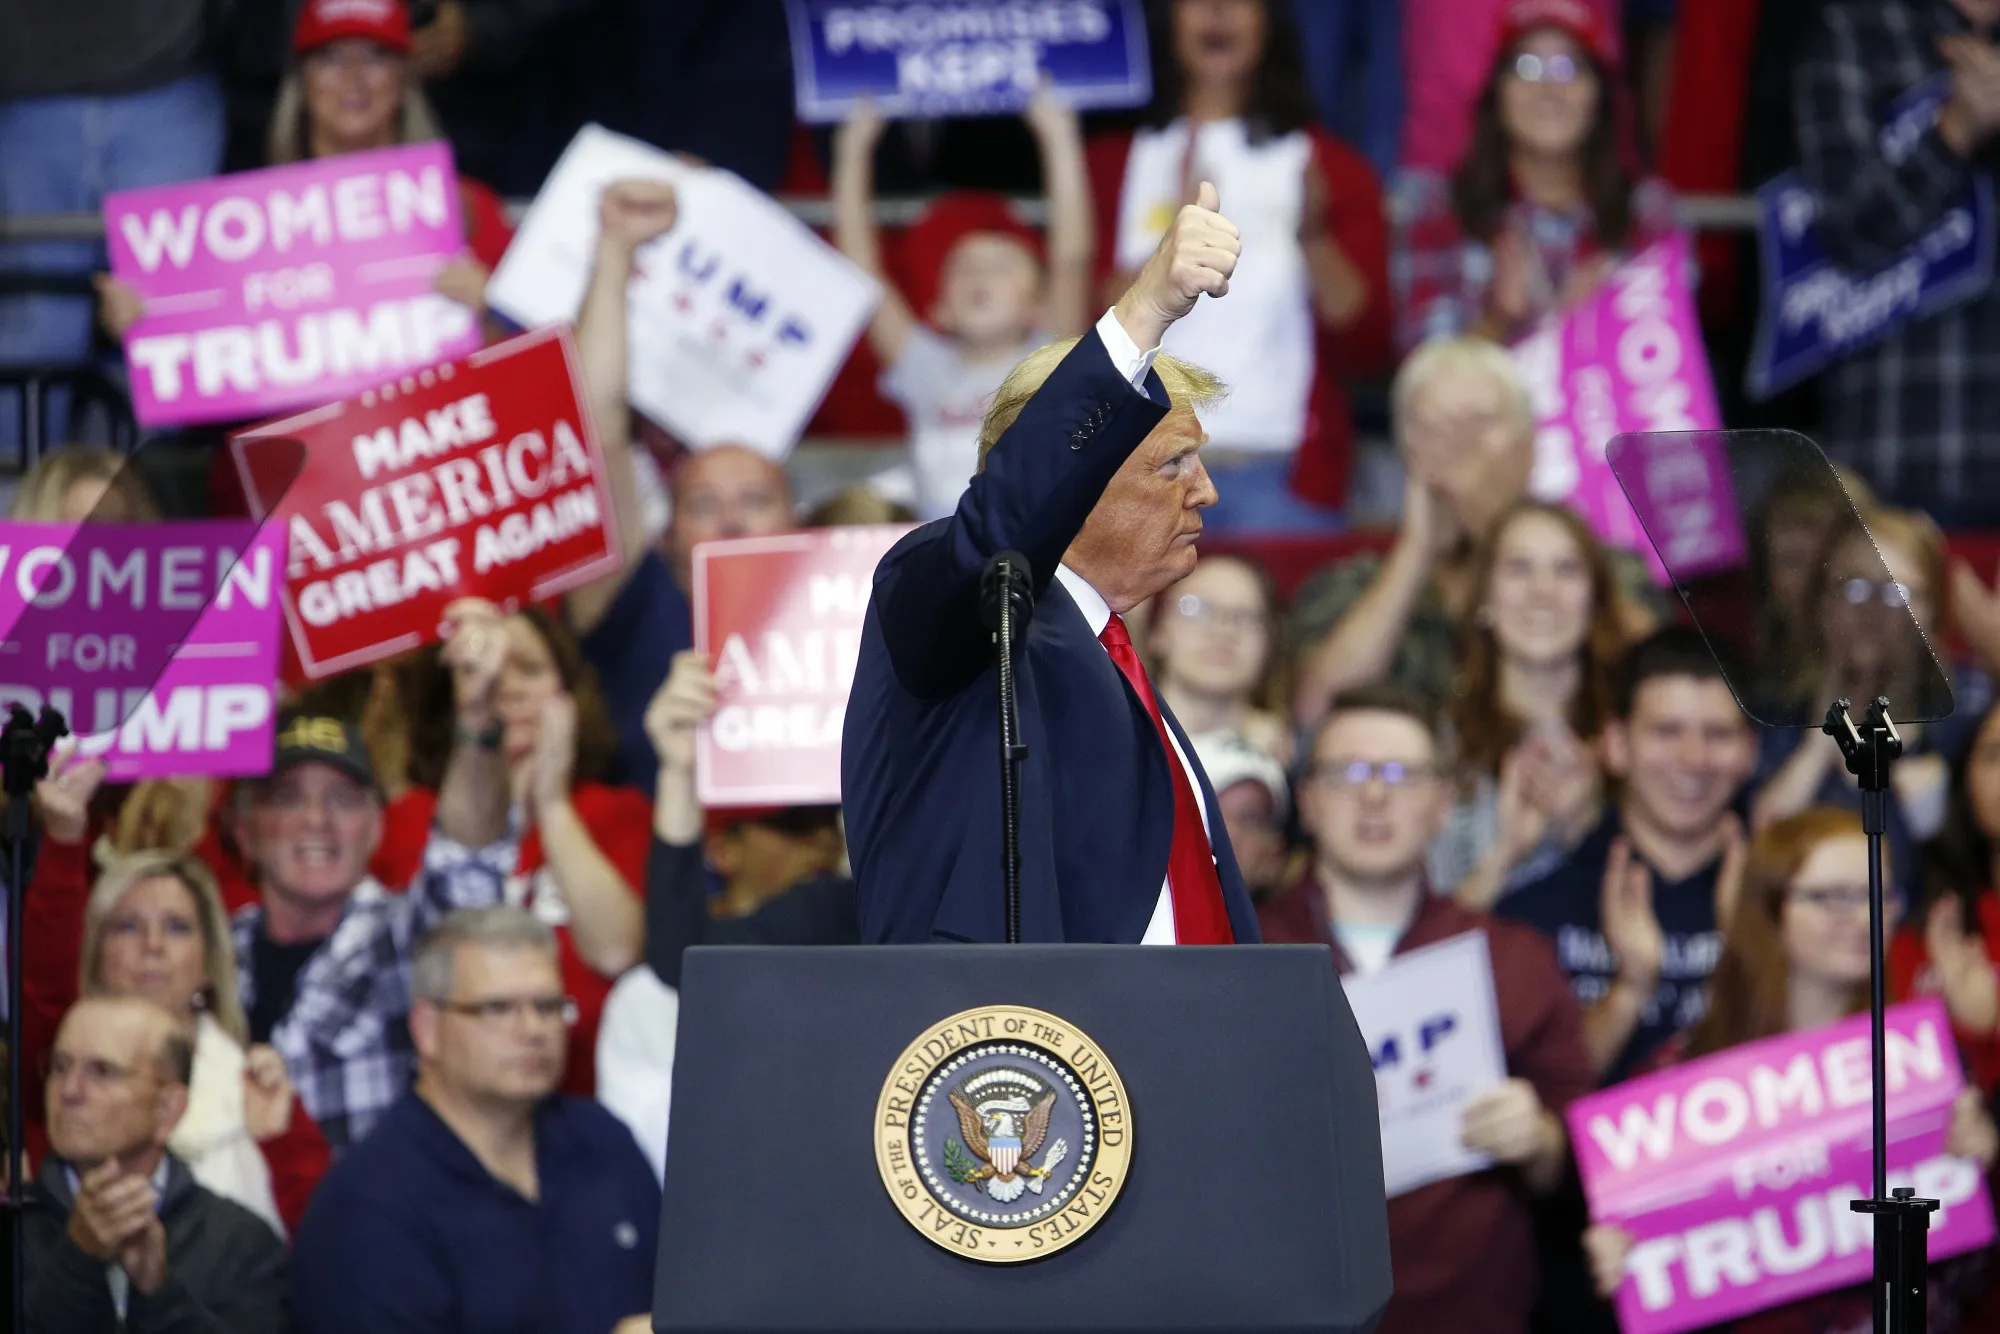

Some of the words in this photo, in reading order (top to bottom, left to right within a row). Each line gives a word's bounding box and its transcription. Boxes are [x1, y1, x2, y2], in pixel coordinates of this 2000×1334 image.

[119, 163, 449, 274] WOMEN
[242, 261, 335, 314] FOR
[655, 236, 814, 350] UMP
[130, 293, 474, 403] TRUMP
[351, 392, 498, 480] MAKE
[286, 417, 596, 579] AMERICA
[0, 544, 273, 611] OMEN
[299, 536, 462, 627] GREAT
[472, 482, 602, 575] AGAIN
[46, 633, 137, 672] FOR
[1003, 1017, 1029, 1034] OF
[1033, 1022, 1066, 1048] THE
[885, 1016, 997, 1130] PRESIDENT
[1070, 1044, 1124, 1148] UNITED
[1586, 1019, 1945, 1172] WOMEN
[886, 1138, 909, 1175] THE
[899, 1177, 919, 1200] OF
[1731, 1136, 1832, 1199] FOR
[917, 1196, 983, 1250] SEAL
[1028, 1170, 1114, 1249] STATES
